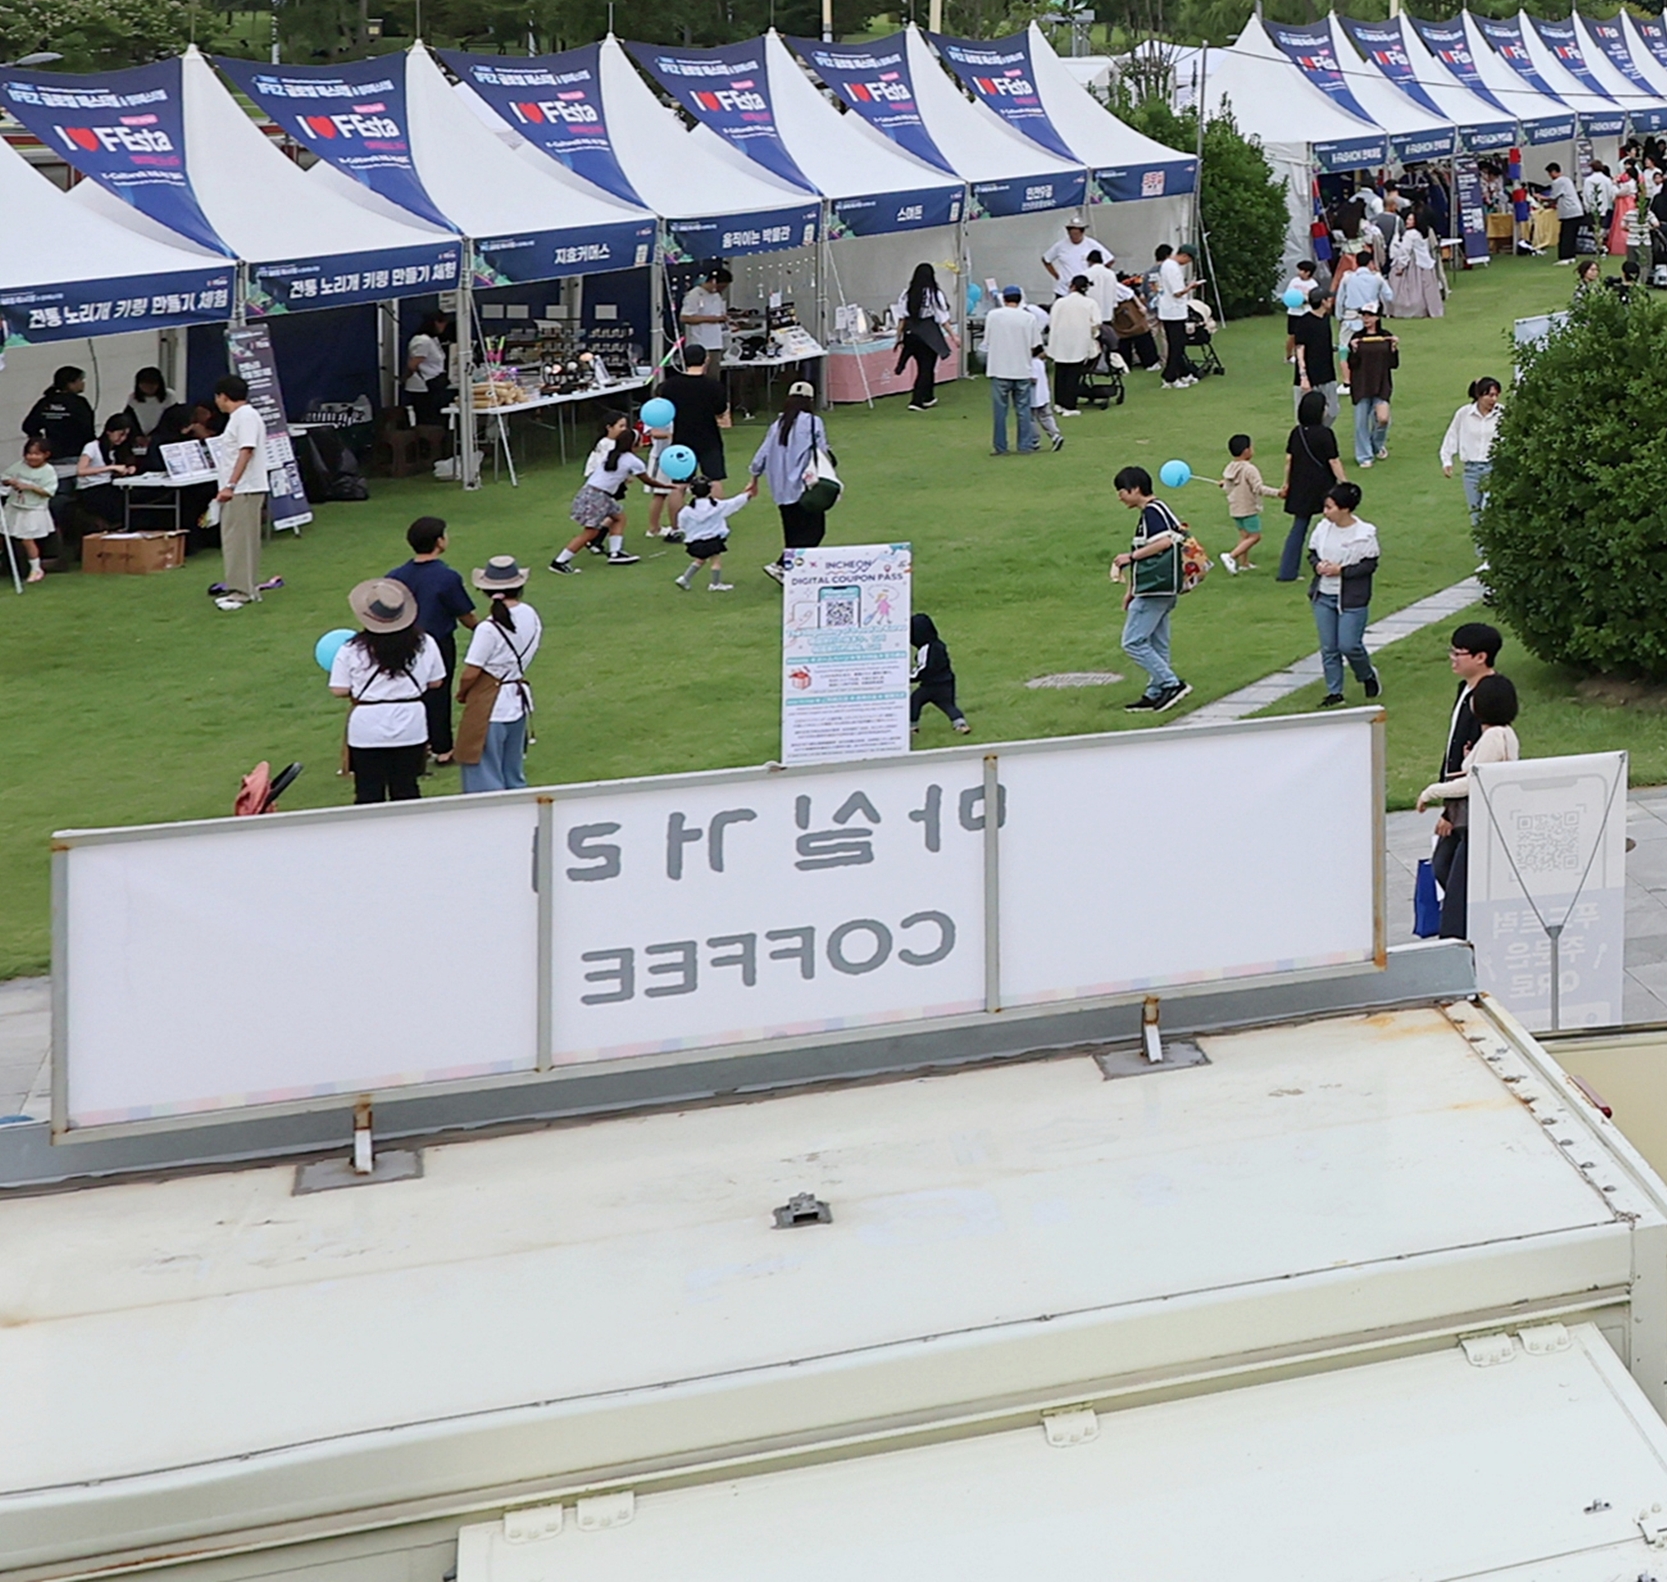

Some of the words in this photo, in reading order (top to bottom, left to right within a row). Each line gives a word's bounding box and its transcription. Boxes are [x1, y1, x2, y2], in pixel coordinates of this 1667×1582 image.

[843, 82, 859, 102] I
[972, 77, 986, 95] I
[509, 102, 528, 124] I
[538, 100, 598, 124] FEsta
[690, 90, 707, 112] I
[714, 89, 767, 112] FEsta
[296, 115, 317, 139] I
[330, 113, 400, 139] FEsta
[53, 125, 78, 151] I
[92, 125, 174, 152] FEsta
[721, 228, 760, 250] 움직이는
[290, 277, 318, 299] 전통
[320, 273, 359, 294] 노리개
[362, 269, 389, 289] 키링
[391, 265, 430, 287] 만들기
[431, 261, 457, 281] 체험
[29, 306, 62, 329] 전통
[64, 300, 110, 325] 노리개
[113, 296, 148, 318] 키링
[151, 293, 195, 315] 만들기
[197, 288, 228, 310] 체험
[825, 560, 871, 569] INCHEON
[791, 576, 829, 586] DIGITAL
[832, 574, 875, 584] COUPON
[878, 573, 903, 581] PASS
